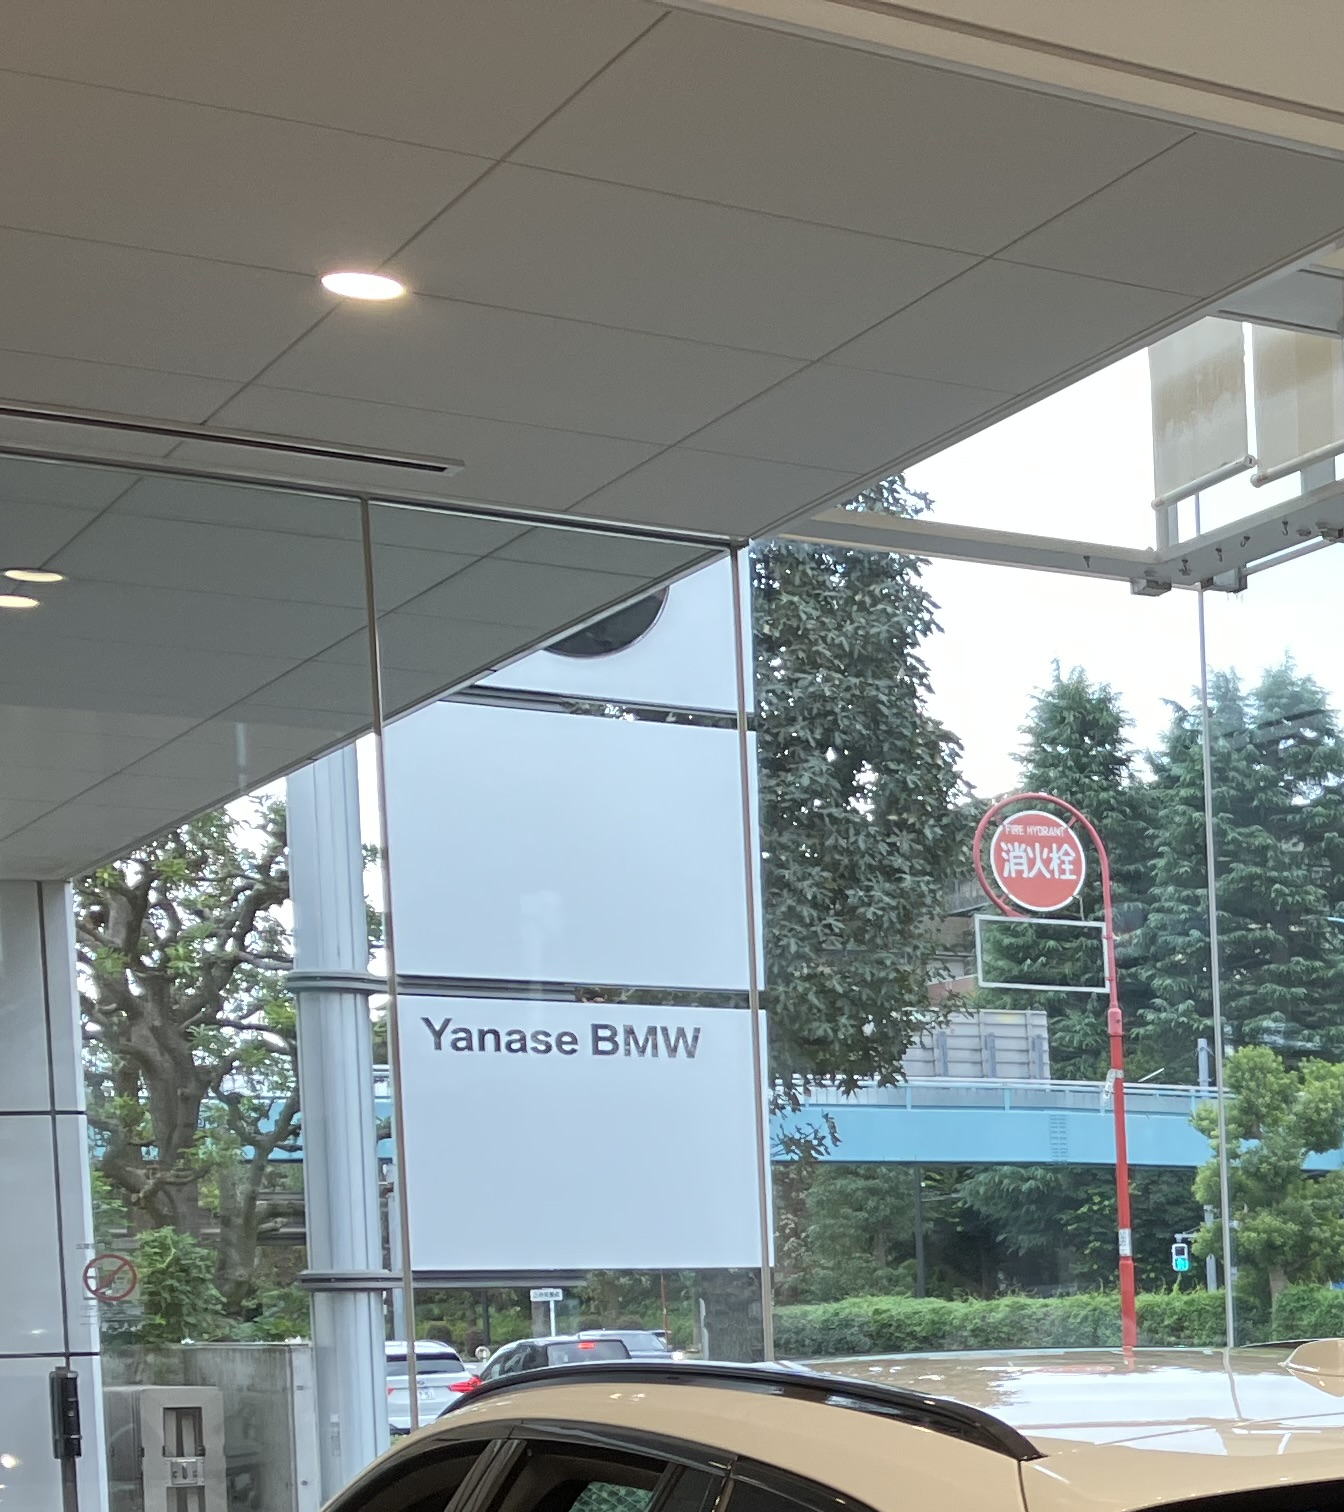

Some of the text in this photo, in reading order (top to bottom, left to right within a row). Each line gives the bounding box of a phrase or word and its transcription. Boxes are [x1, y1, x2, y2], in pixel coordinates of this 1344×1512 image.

[1005, 824, 1065, 837] FIRE HYDRANT
[1000, 841, 1077, 880] 消火栓
[420, 1016, 701, 1059] Yanase BMW
